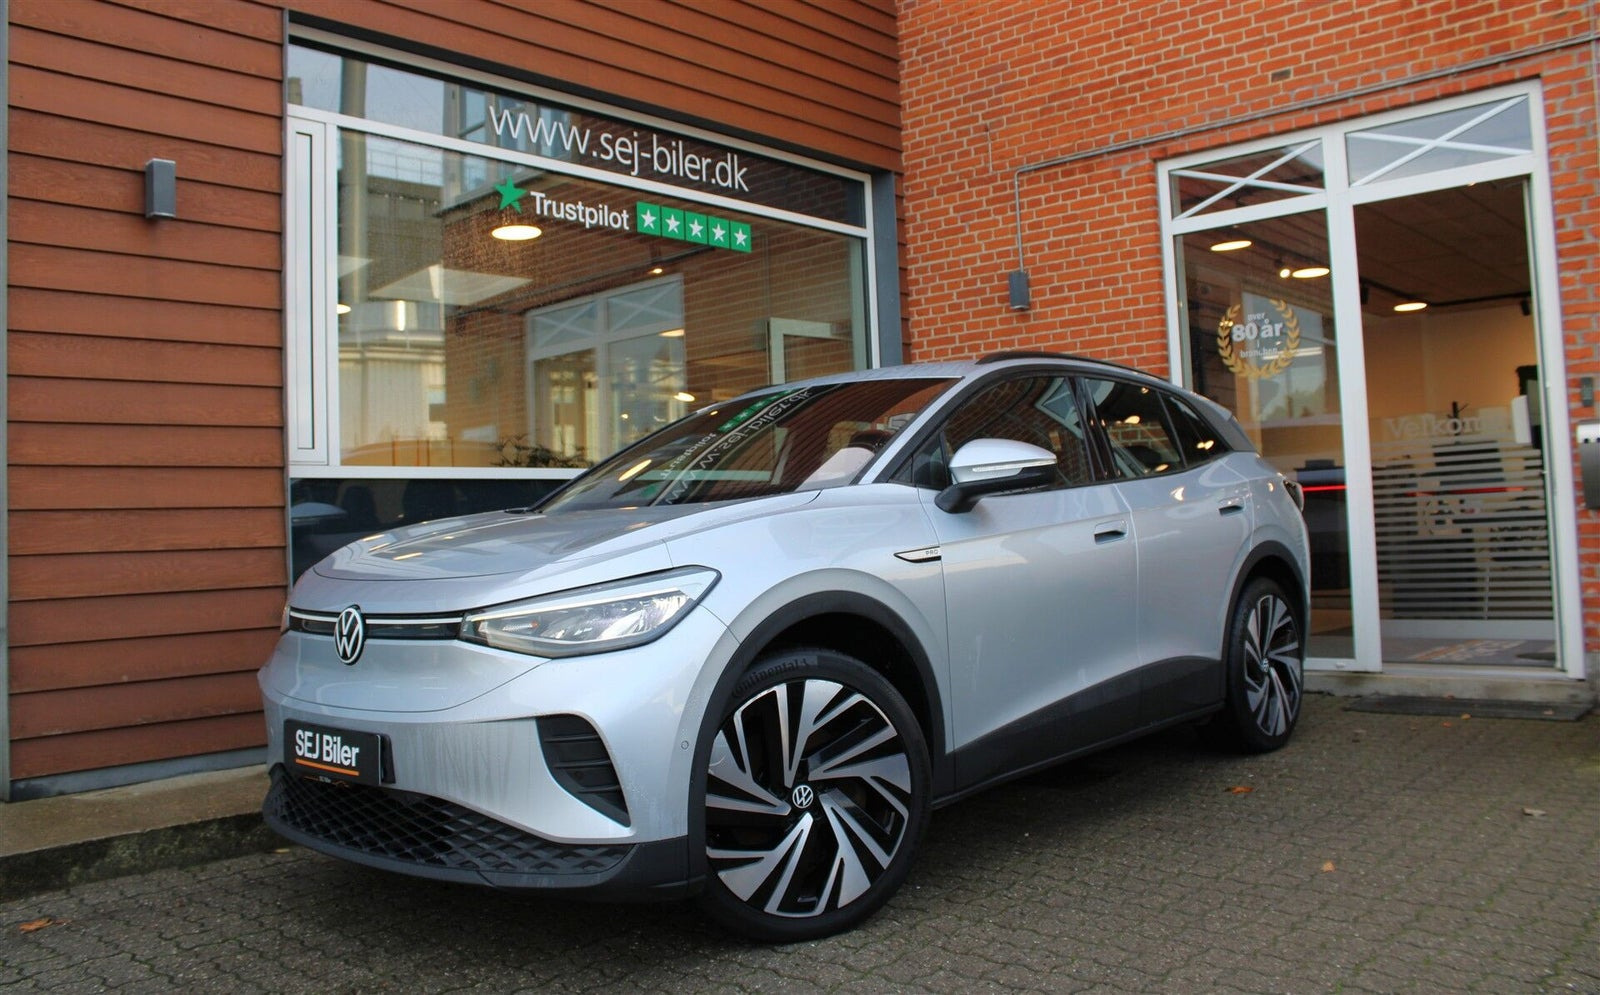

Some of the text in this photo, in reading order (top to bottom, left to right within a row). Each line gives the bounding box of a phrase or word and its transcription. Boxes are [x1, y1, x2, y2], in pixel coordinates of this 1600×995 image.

[489, 105, 750, 192] www.sej-biler.dk
[530, 191, 630, 231] Trustpilot
[1232, 318, 1283, 342] 80 år
[295, 729, 360, 768] SEJ Biler
